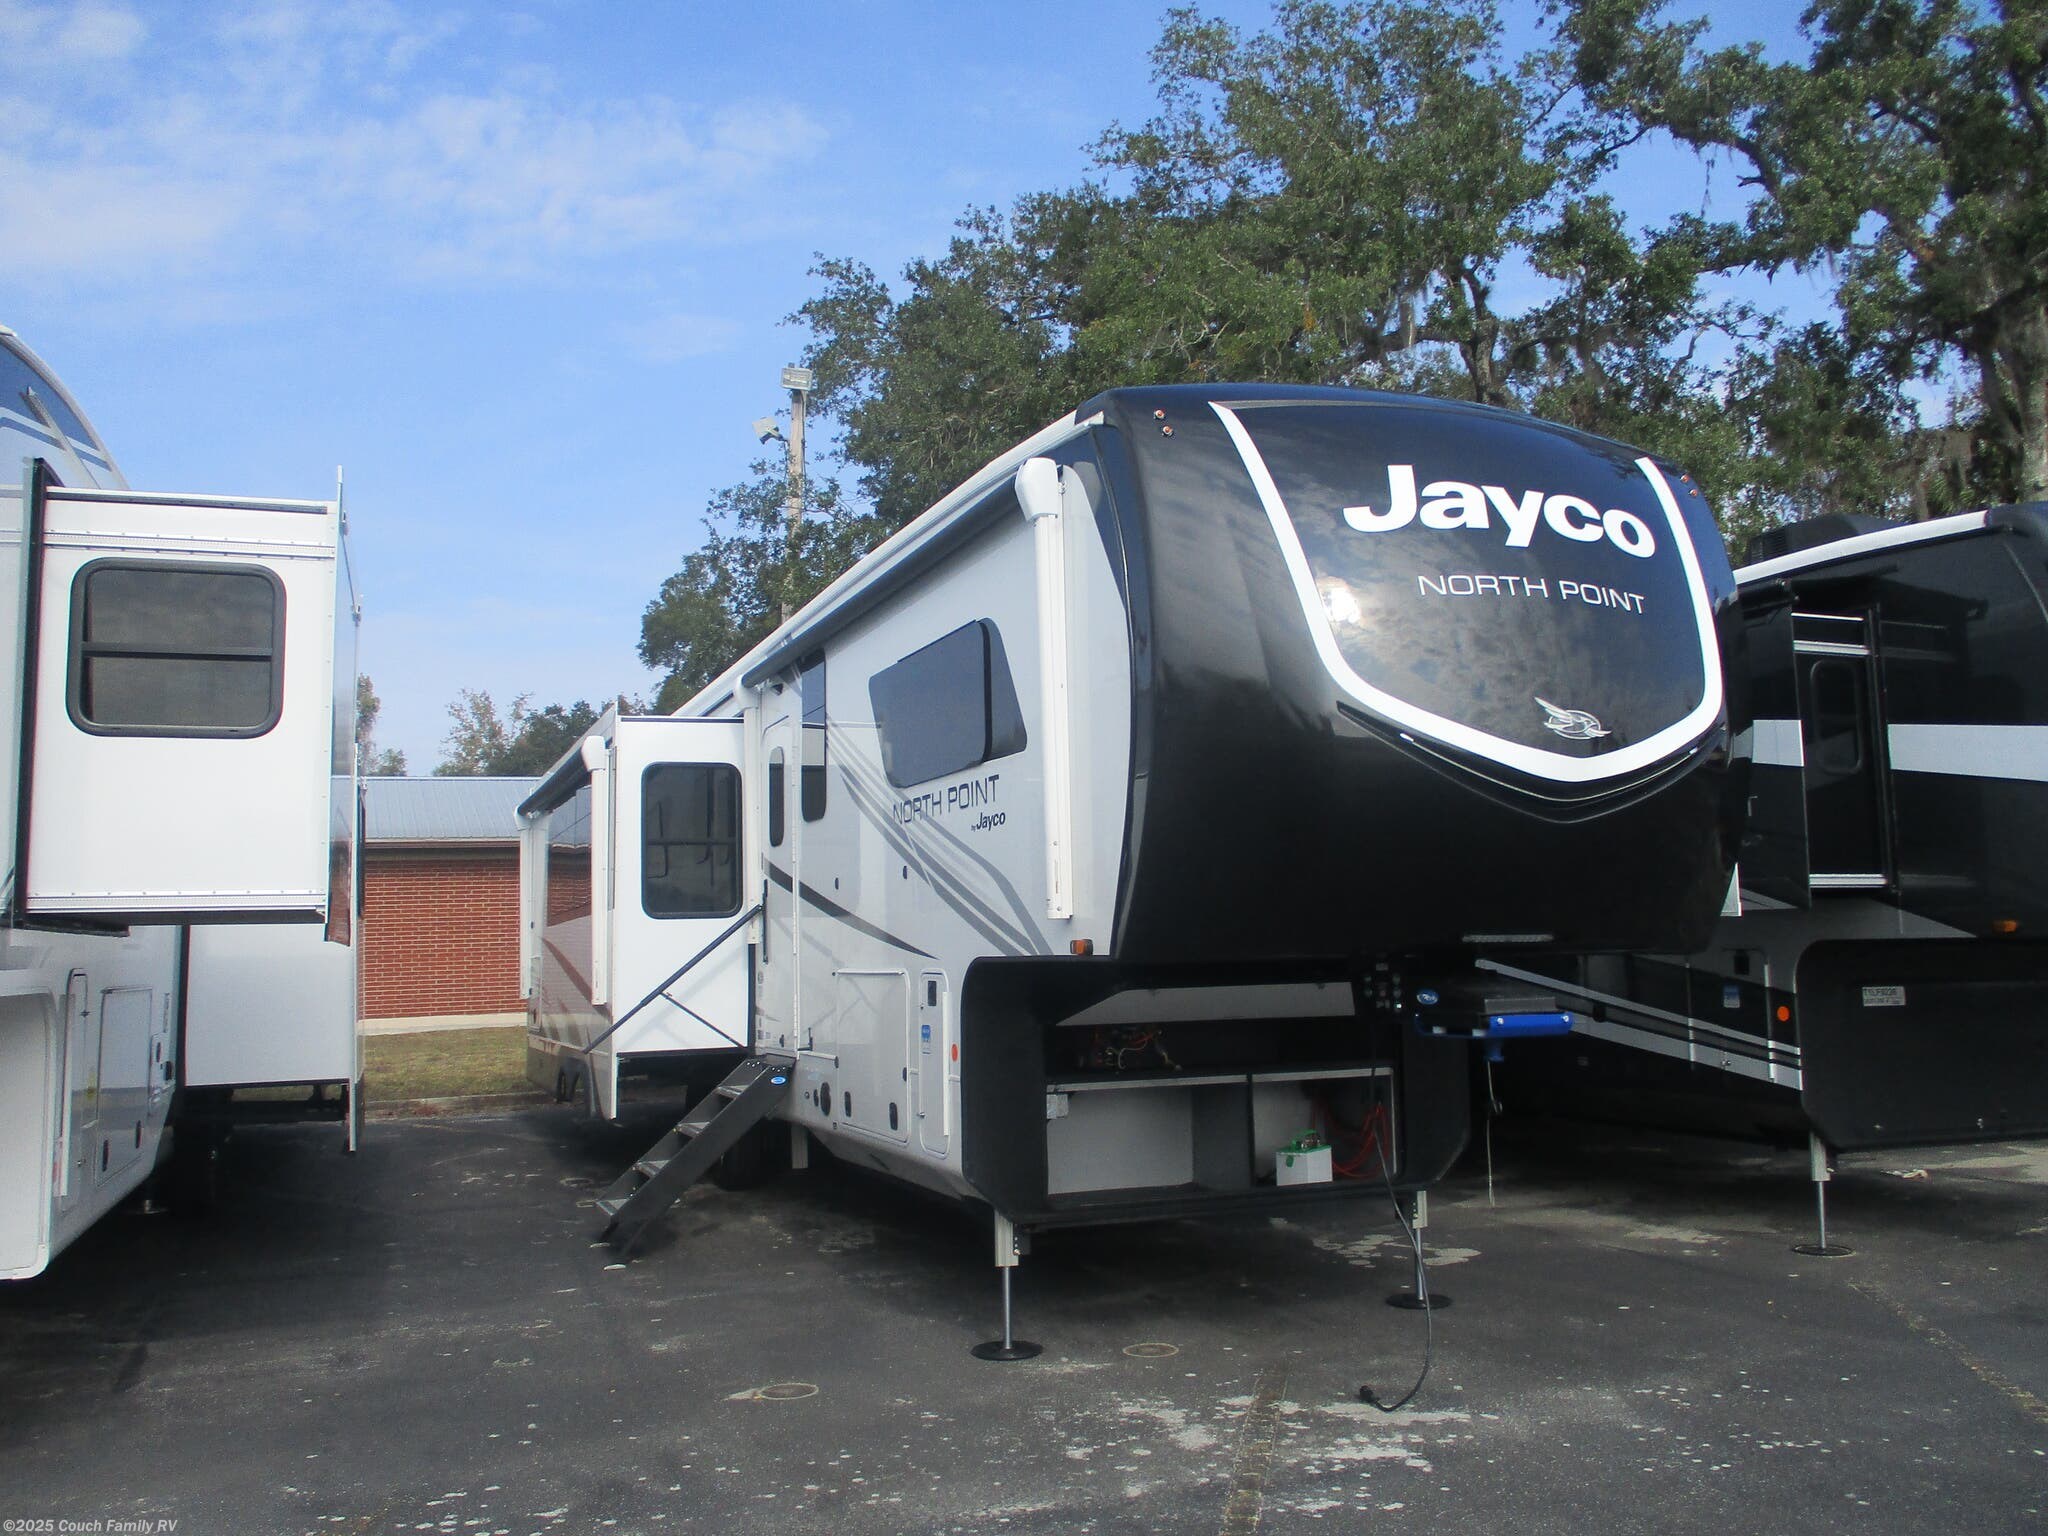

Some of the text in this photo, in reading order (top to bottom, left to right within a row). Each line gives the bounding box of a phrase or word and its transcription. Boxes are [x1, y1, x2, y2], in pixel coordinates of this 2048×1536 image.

[1343, 464, 1656, 558] Jayco
[1418, 575, 1645, 615] NORTH POINT
[893, 774, 999, 825] NORTH POINT
[976, 812, 1006, 831] Jayco
